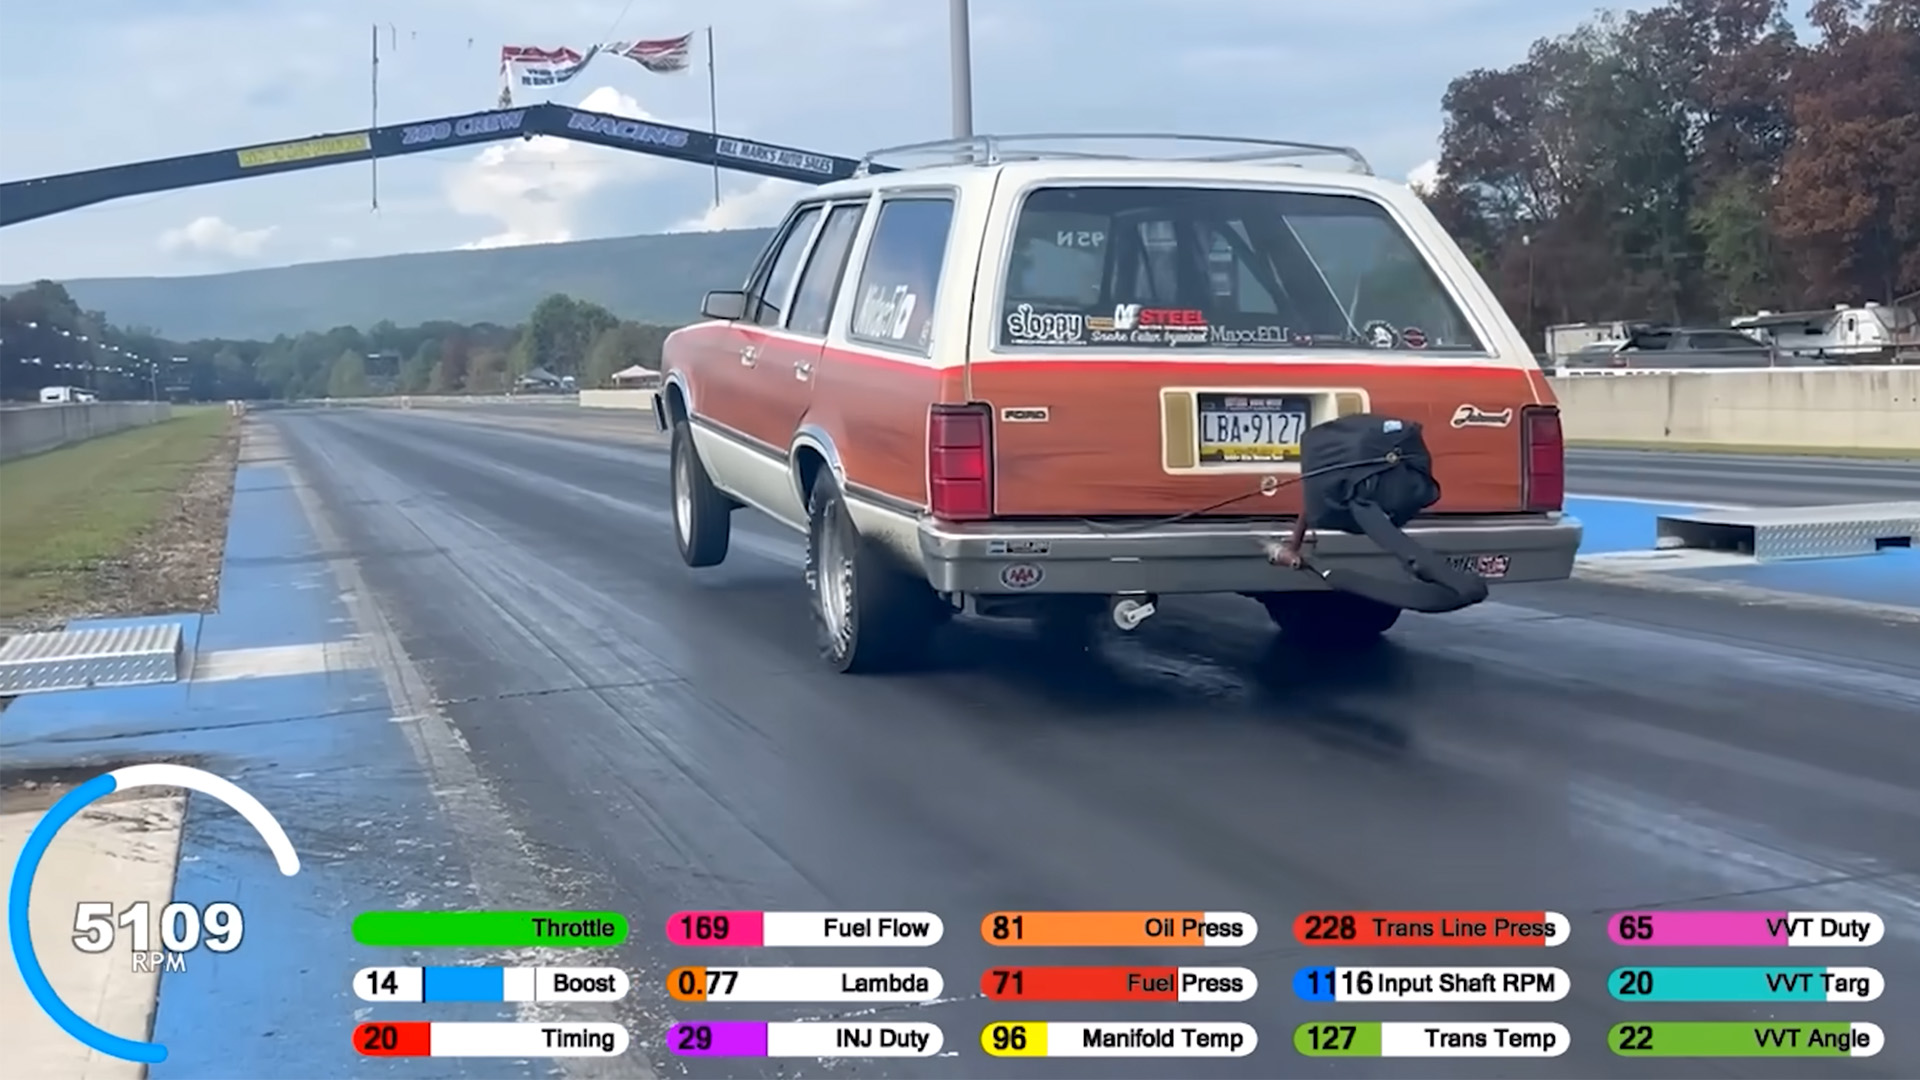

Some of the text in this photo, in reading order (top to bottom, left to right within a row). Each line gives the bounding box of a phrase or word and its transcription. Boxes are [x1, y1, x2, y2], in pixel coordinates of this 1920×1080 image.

[402, 110, 526, 145] ZOO CREW
[567, 112, 689, 147] RACING
[719, 140, 738, 155] BILL
[777, 150, 803, 166] AUTO
[803, 156, 832, 171] SALES
[1139, 309, 1206, 325] STEEL
[1004, 410, 1046, 419] FORD
